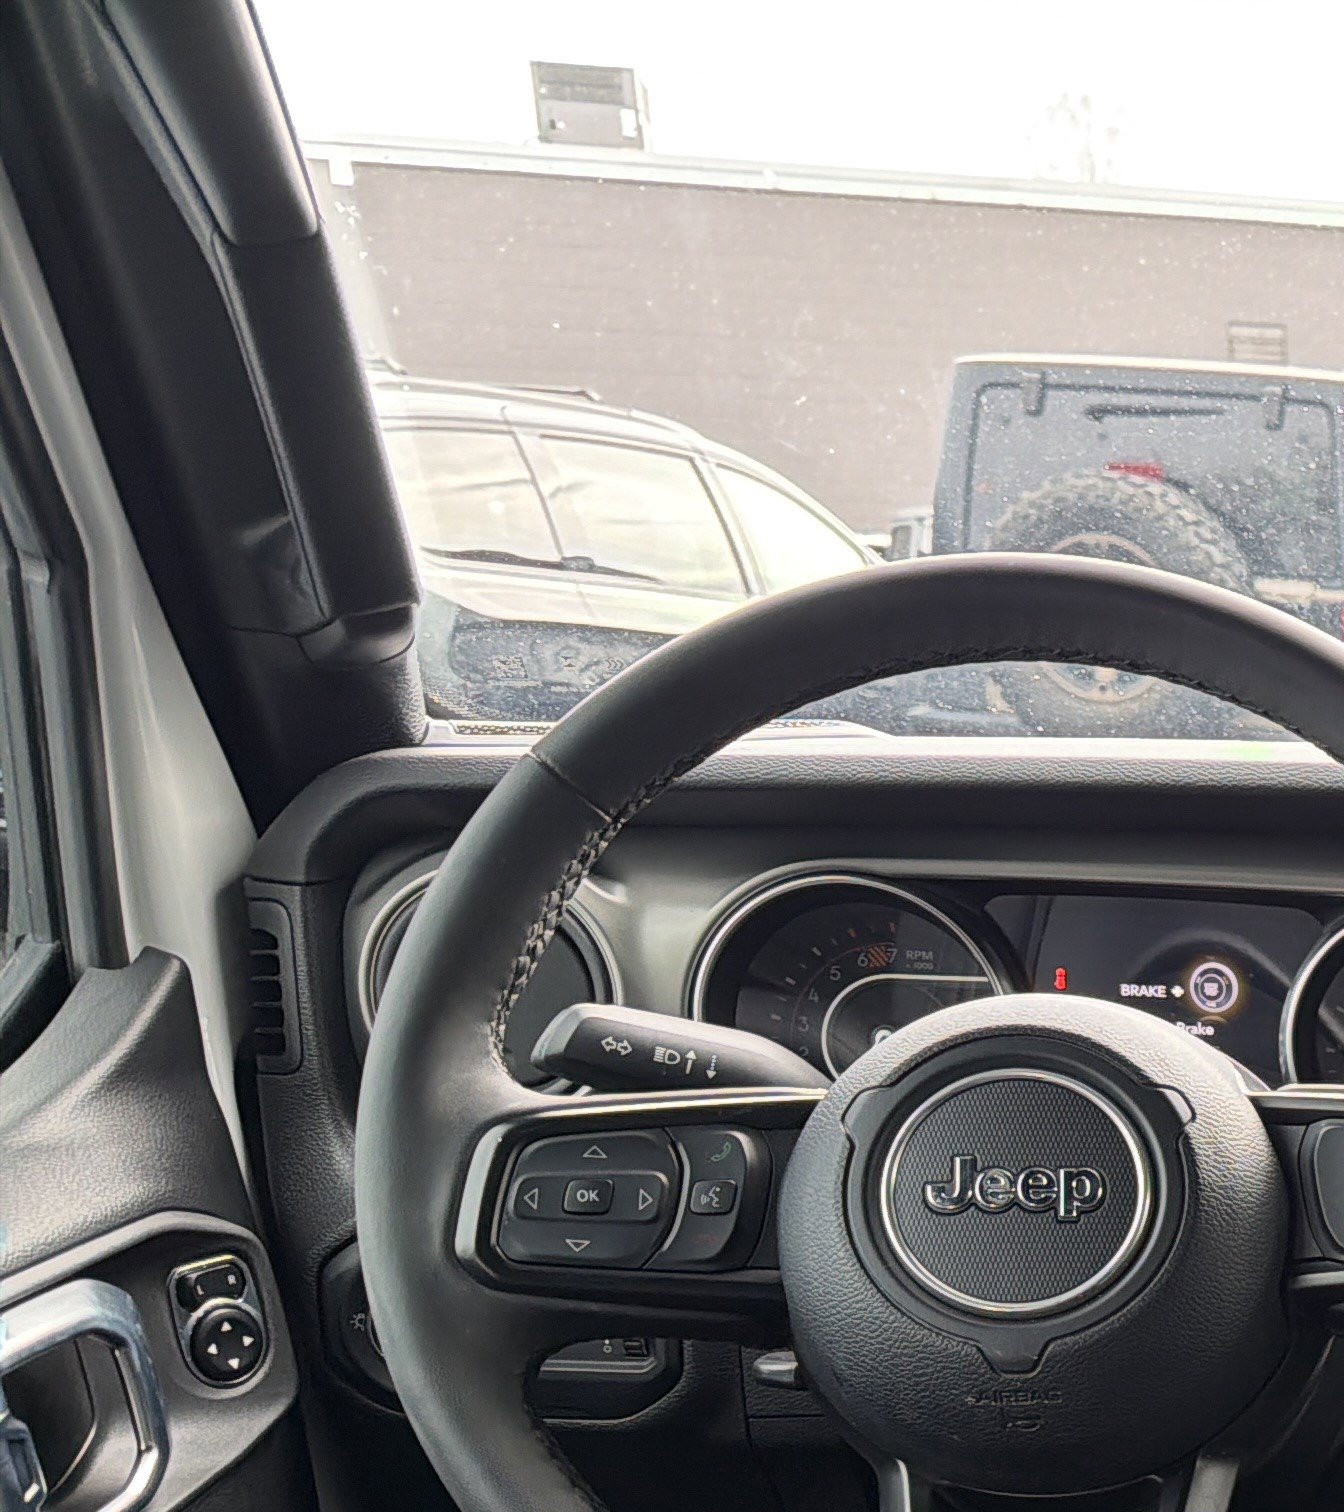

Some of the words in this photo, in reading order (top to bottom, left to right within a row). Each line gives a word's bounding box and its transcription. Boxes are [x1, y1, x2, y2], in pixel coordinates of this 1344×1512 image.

[857, 953, 869, 967] 6
[905, 950, 934, 960] RPM
[829, 965, 842, 981] 5
[1119, 983, 1168, 998] BRAKE
[924, 1154, 1107, 1222] Jeep
[576, 1189, 600, 1203] OK
